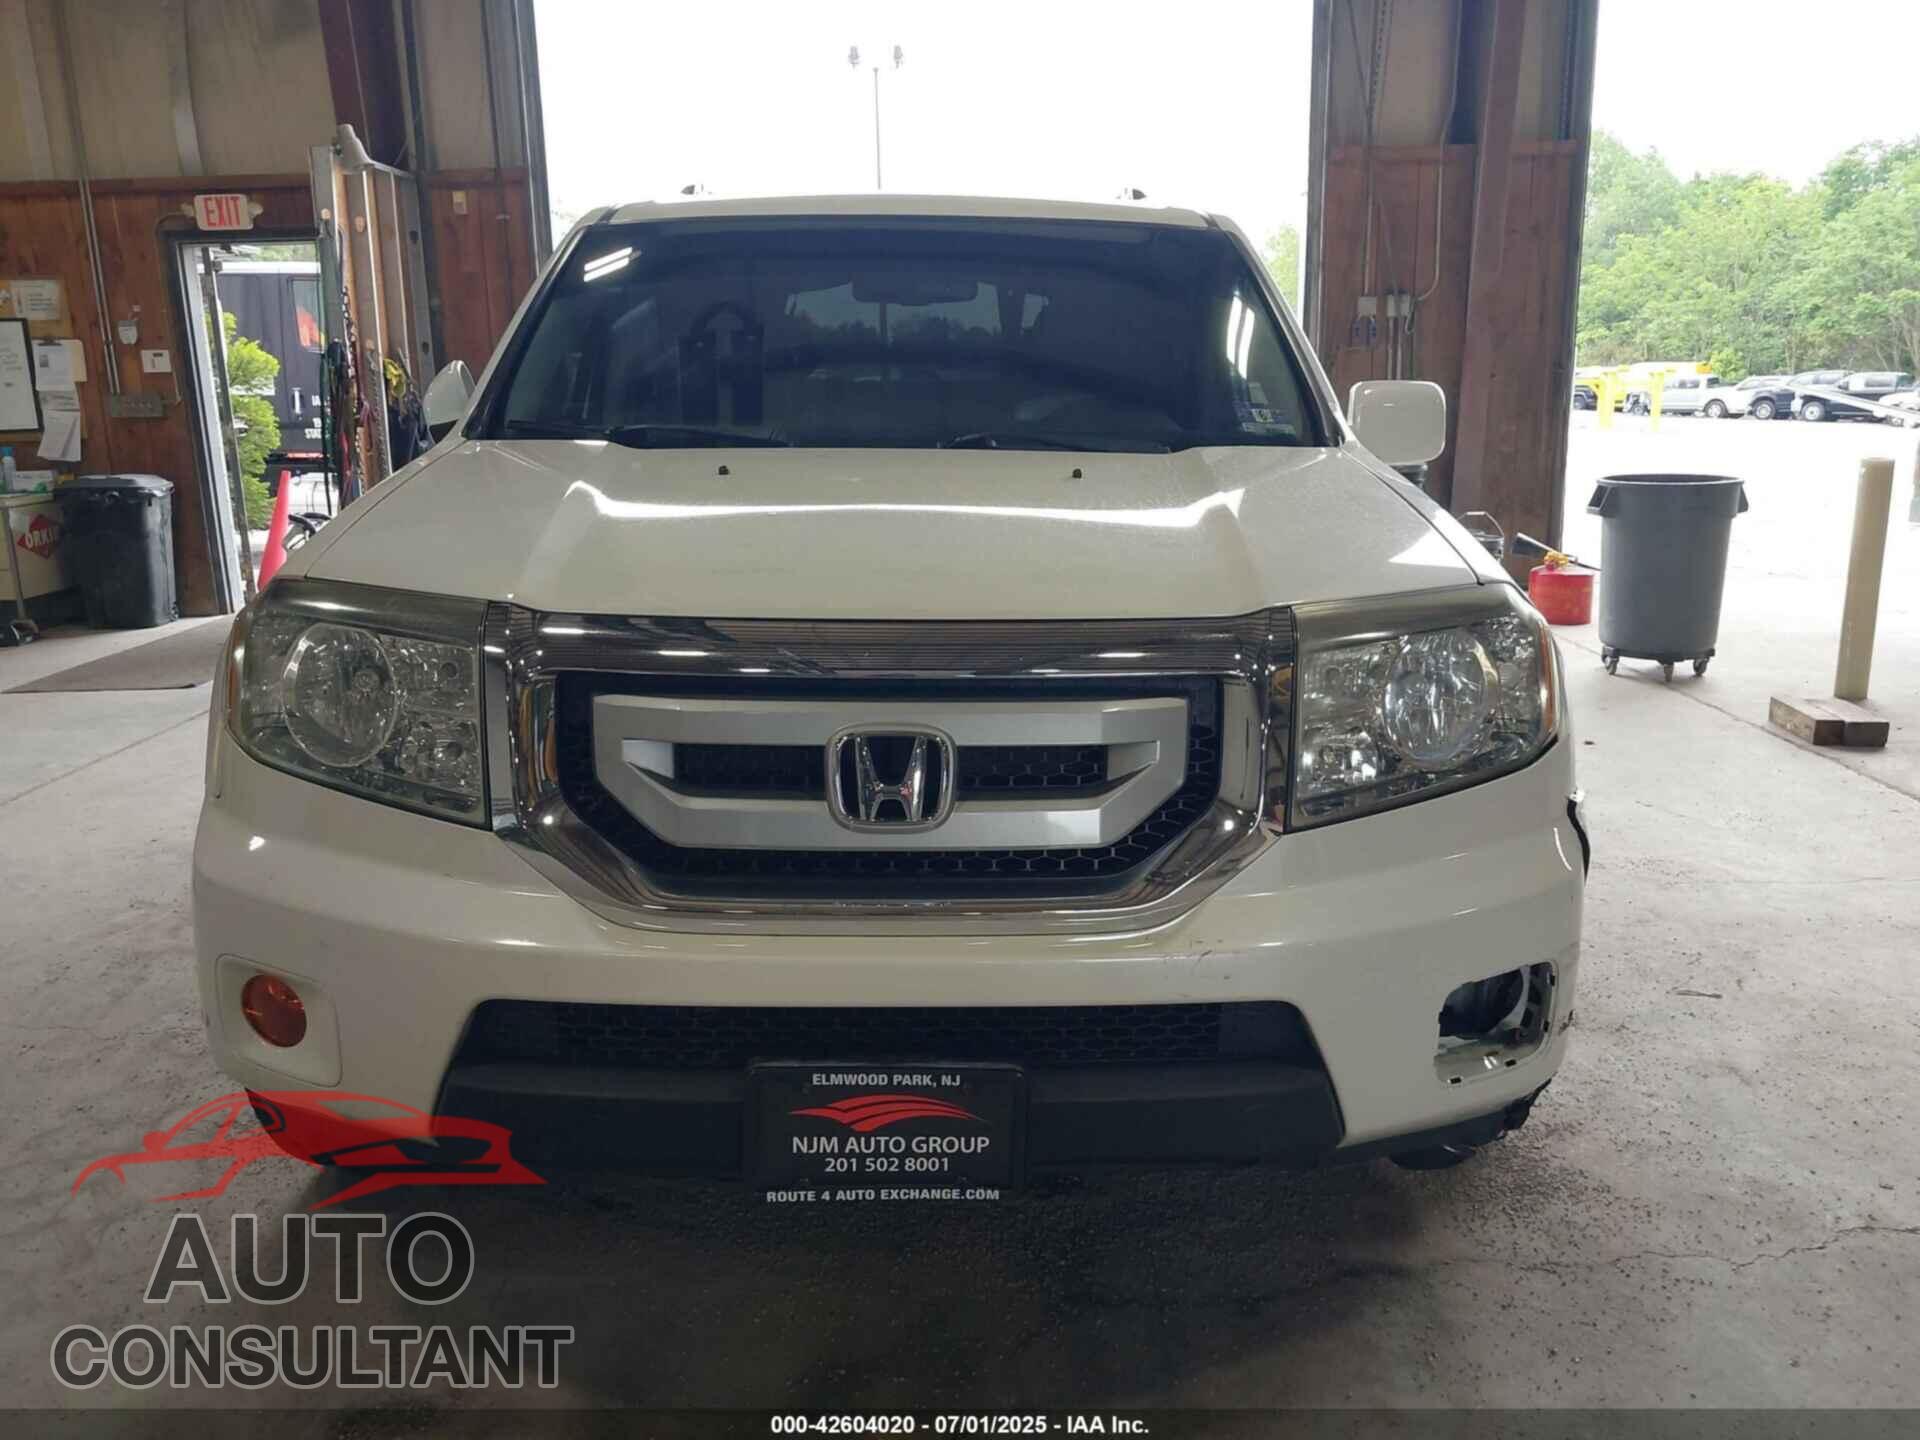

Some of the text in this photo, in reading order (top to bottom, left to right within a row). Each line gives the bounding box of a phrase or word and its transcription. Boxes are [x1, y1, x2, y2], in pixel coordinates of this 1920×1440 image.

[203, 195, 241, 228] EXIT
[812, 1073, 961, 1088] ELMWOOD PARK, NJ
[792, 1136, 990, 1154] NJM AUTO GROUP
[825, 1157, 948, 1172] 201 502 8001
[766, 1188, 1000, 1203] ROUTE 4 AUTO EXCHANGE.COM
